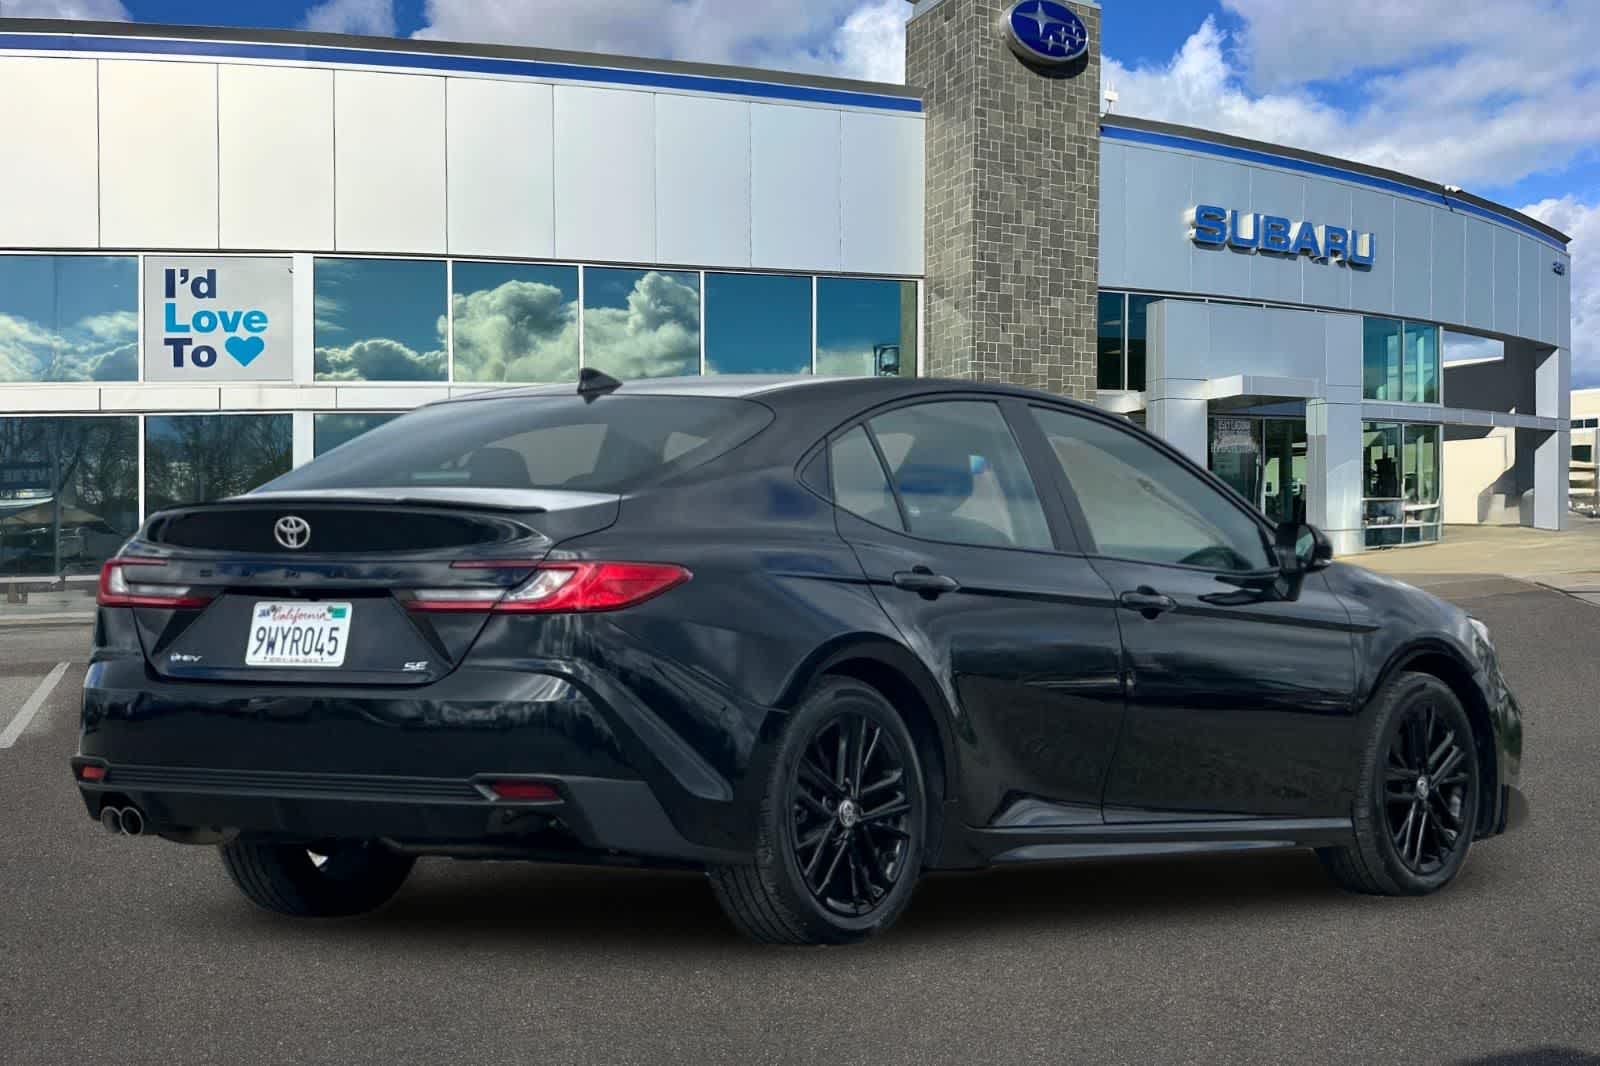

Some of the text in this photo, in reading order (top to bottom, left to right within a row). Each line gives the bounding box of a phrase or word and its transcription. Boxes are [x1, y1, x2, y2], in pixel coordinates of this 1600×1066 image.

[1192, 204, 1376, 268] SUBARU
[165, 302, 268, 333] Love
[164, 337, 217, 368] To
[271, 606, 331, 625] California
[252, 626, 340, 656] 9WYR045
[402, 660, 429, 671] SE
